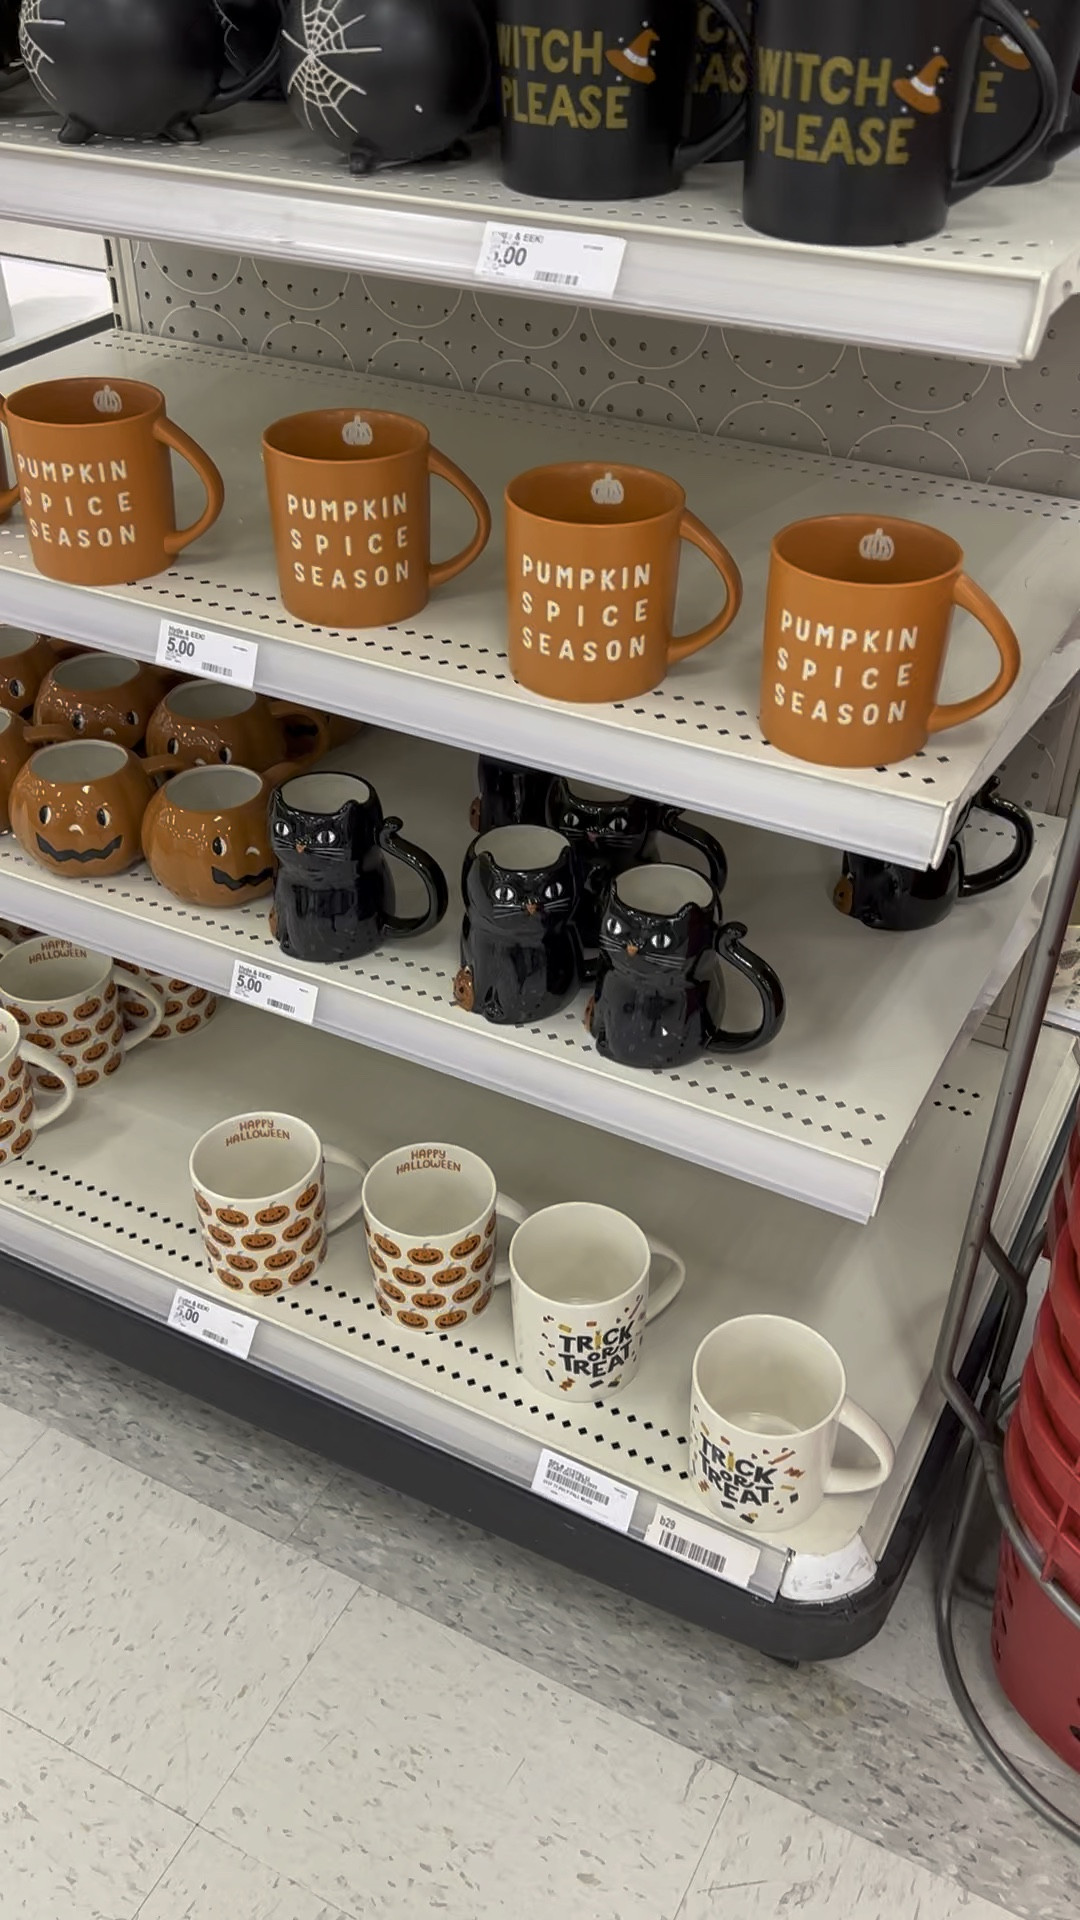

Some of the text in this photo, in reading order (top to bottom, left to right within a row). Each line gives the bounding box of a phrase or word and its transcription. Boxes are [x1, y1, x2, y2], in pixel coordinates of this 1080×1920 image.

[497, 22, 603, 76] WITCH
[757, 46, 892, 108] WITCH
[501, 76, 631, 130] PLEASE
[759, 105, 915, 167] PLEASE
[17, 453, 127, 483] PUMPKIN
[23, 486, 132, 516] SPICE
[287, 492, 407, 522] PUMPKIN
[29, 518, 135, 547] SEASON
[290, 526, 408, 556] SPICE
[294, 560, 409, 589] SEASON
[522, 553, 650, 591] PUMPKIN
[522, 591, 648, 627] SPICE
[522, 626, 645, 662] SEASON
[781, 609, 918, 653] PUMPKIN
[167, 636, 195, 657] 5.00
[777, 647, 912, 690] SPICE
[774, 682, 906, 726] SEASON
[28, 949, 87, 965] HALLOWEEN
[237, 974, 262, 994] 5.00
[225, 1128, 290, 1147] HALLOWEEN
[239, 1119, 274, 1131] HAPPY
[396, 1159, 461, 1175] HALLOWEEN
[411, 1149, 446, 1161] HAPPY
[559, 1320, 634, 1353] TRICK
[558, 1339, 632, 1378] TREAT
[587, 1345, 620, 1362] OR
[700, 1431, 778, 1485] TRICK
[699, 1450, 774, 1506] TREAT
[719, 1469, 755, 1488] OR
[659, 1515, 676, 1530] b29
